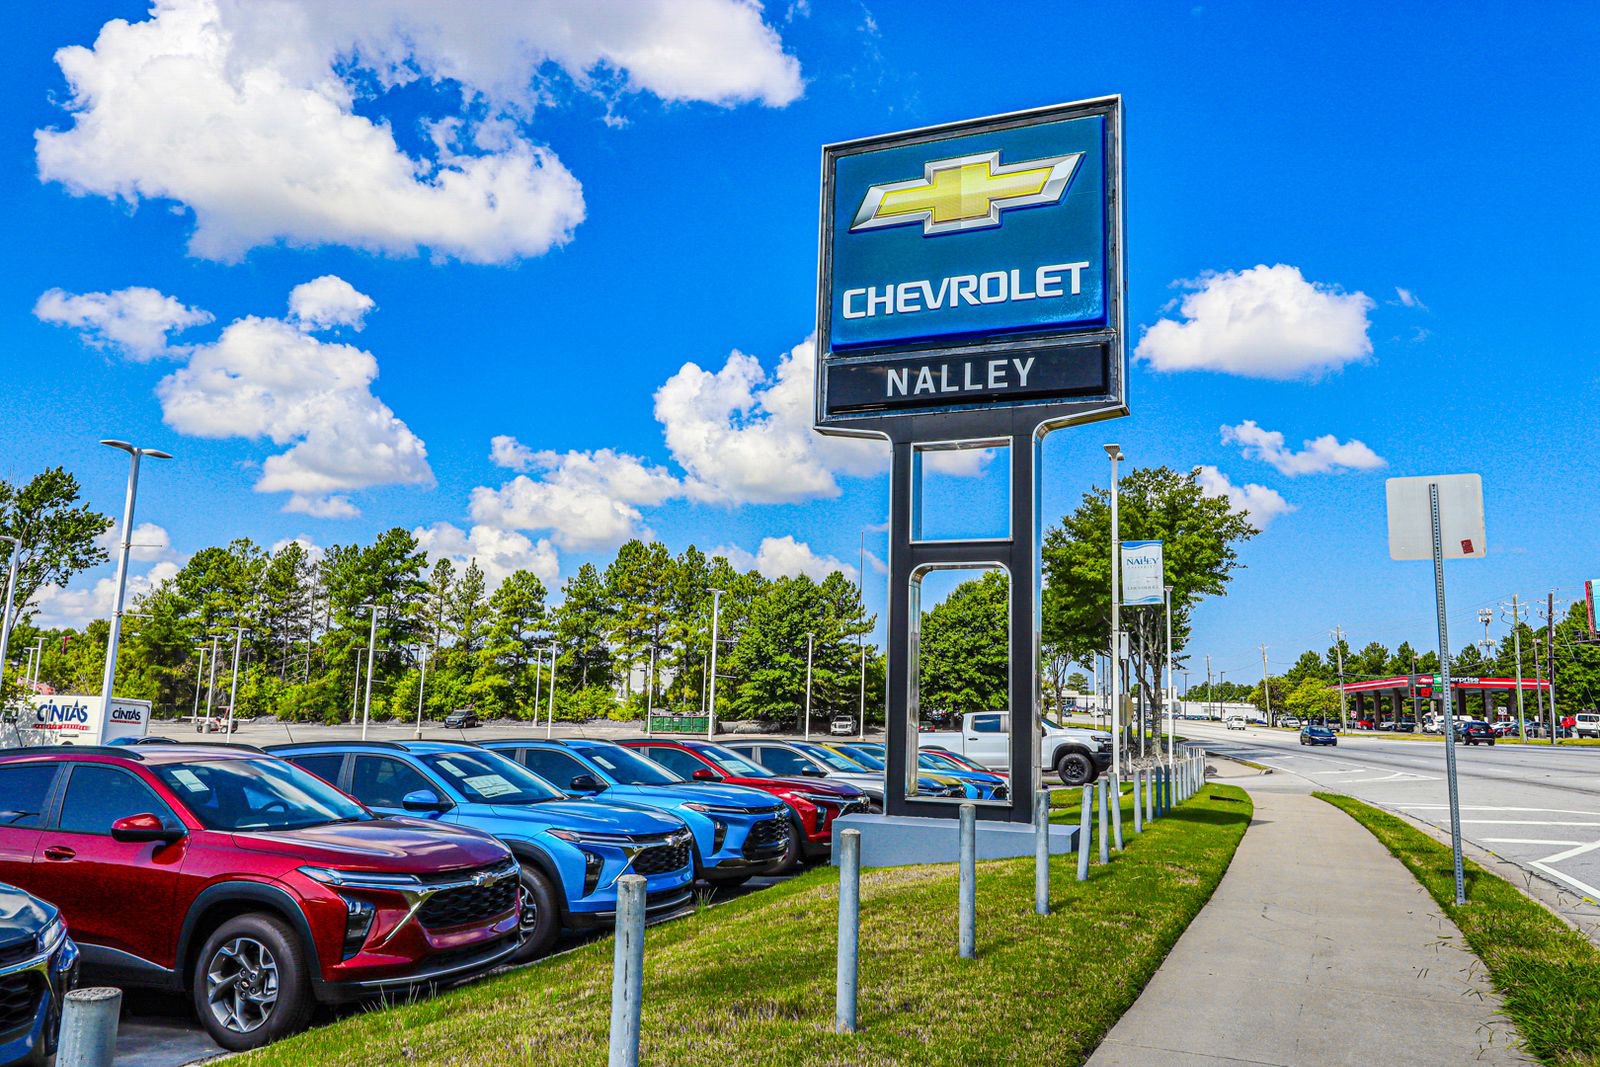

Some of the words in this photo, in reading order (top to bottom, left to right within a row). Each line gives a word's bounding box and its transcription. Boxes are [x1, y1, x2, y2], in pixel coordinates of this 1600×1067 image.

[842, 261, 1089, 319] CHEVROLET
[886, 357, 1035, 397] NALLEY
[1126, 556, 1159, 565] NALLEY
